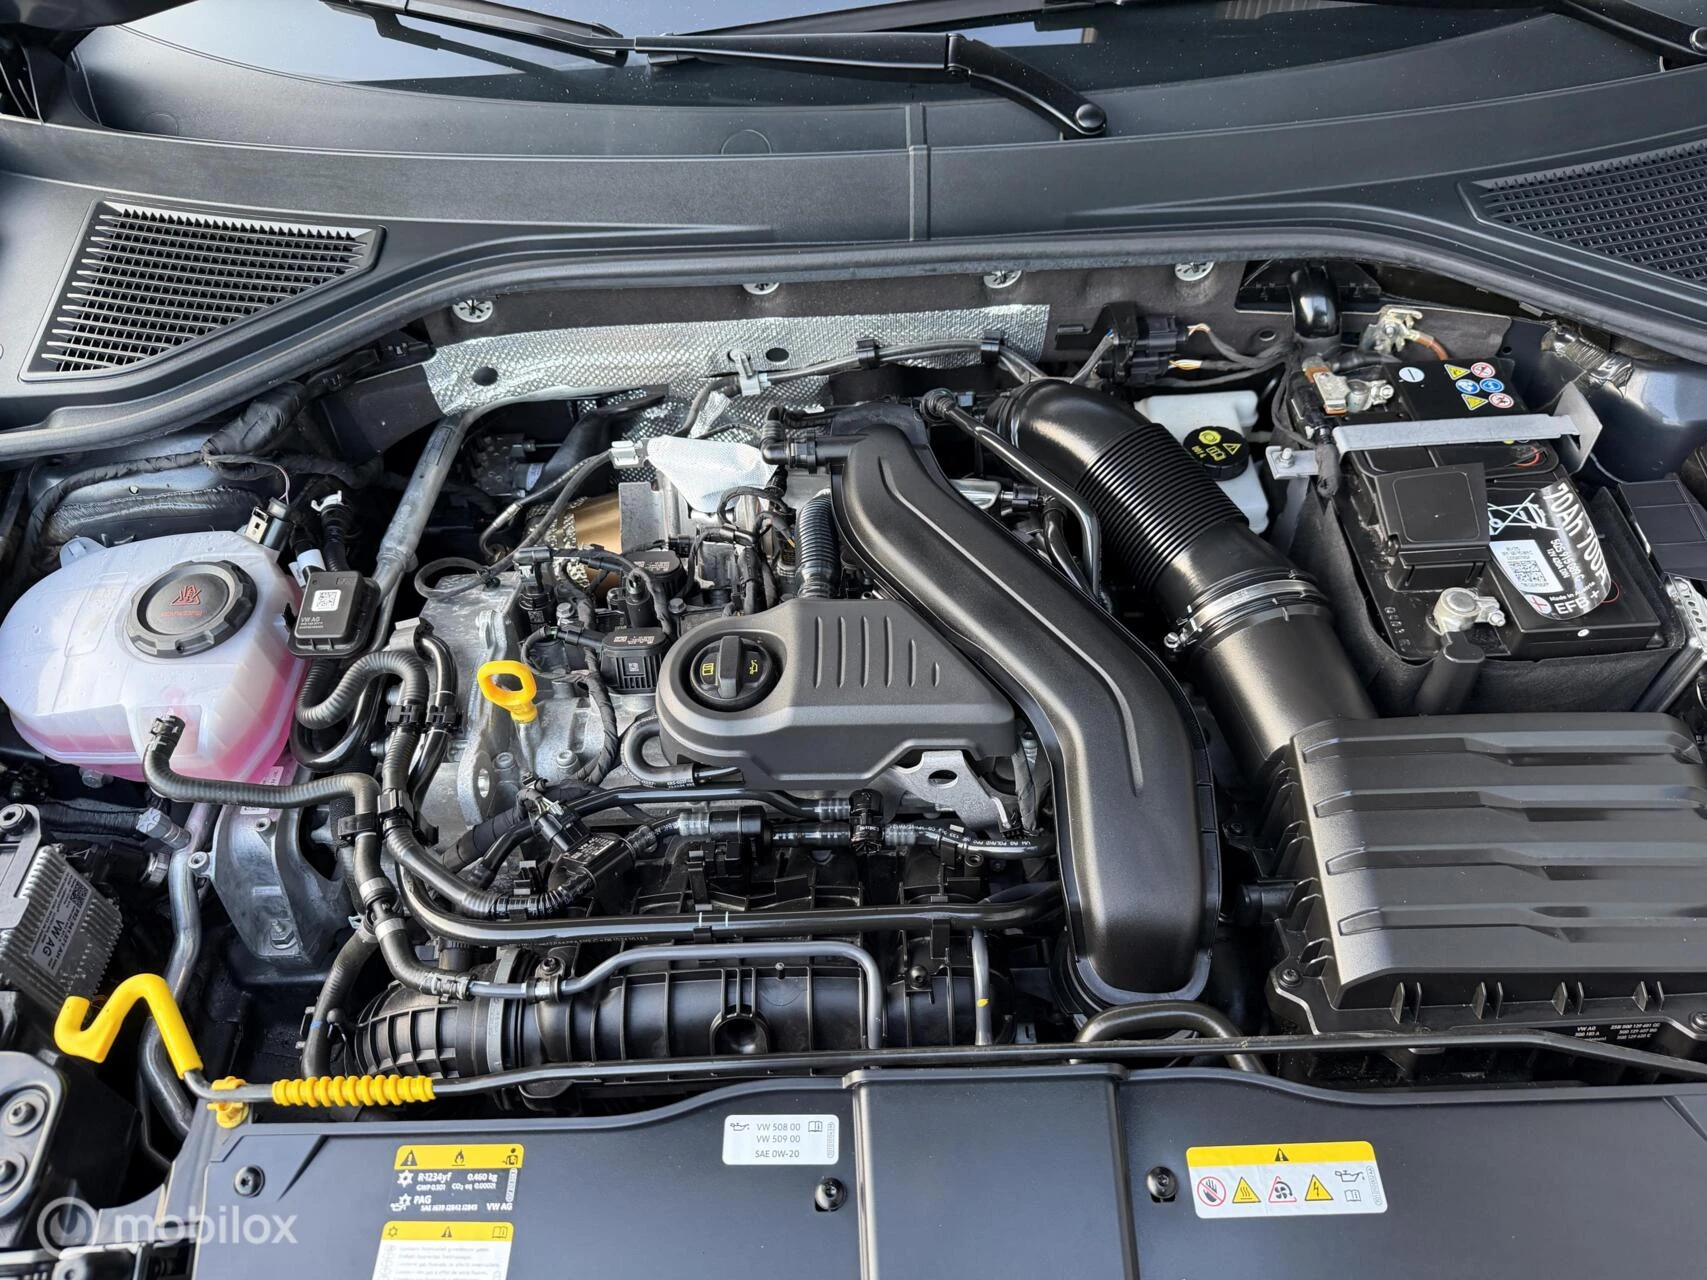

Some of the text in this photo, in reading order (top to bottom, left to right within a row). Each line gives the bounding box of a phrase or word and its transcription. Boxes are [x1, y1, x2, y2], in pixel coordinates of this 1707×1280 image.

[1543, 482, 1608, 586] 70Ah 700A
[1554, 597, 1590, 614] EFB
[51, 919, 64, 939] VW
[42, 938, 54, 956] AG
[757, 1123, 800, 1131] VW 508 00
[757, 1135, 800, 1143] VW 509 00
[755, 1150, 800, 1158] SAE 0W-20
[488, 1173, 498, 1182] kg
[414, 1196, 432, 1204] PAG
[486, 1203, 500, 1211] VW
